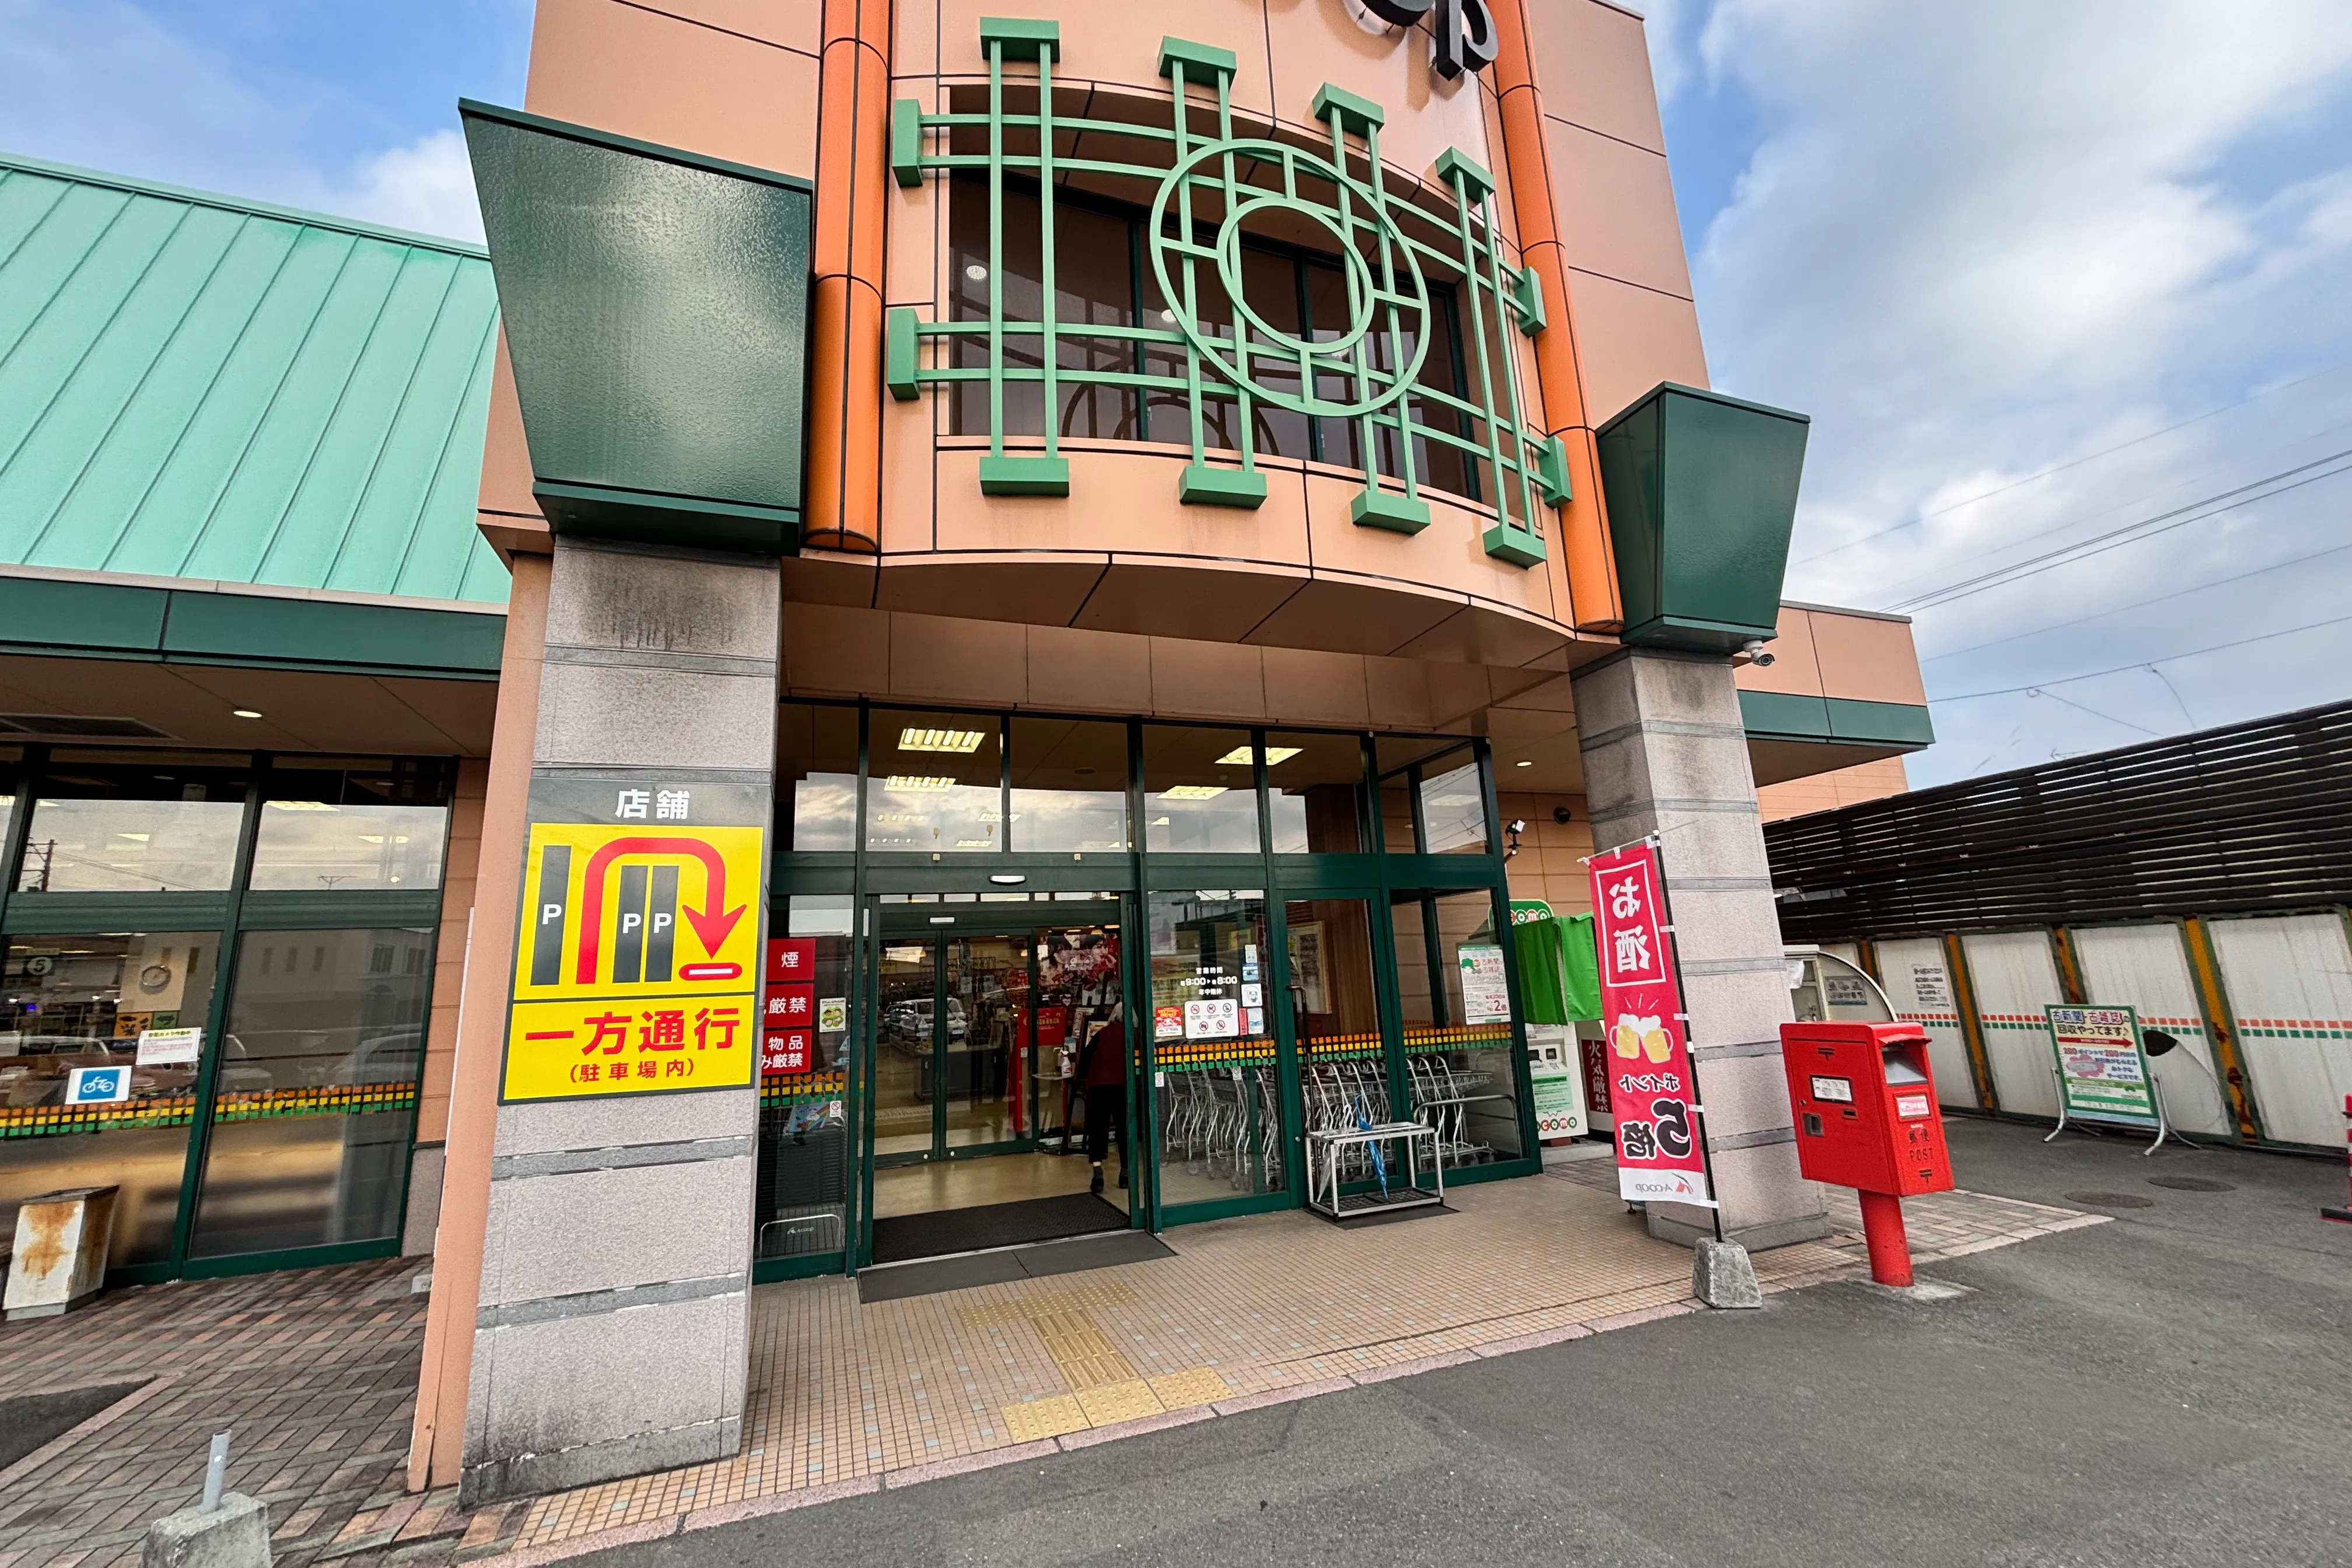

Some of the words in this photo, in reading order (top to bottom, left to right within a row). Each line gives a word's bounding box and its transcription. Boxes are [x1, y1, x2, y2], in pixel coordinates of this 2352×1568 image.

[615, 789, 690, 820] 店舗
[542, 904, 562, 925] P
[623, 913, 641, 934] P
[653, 912, 672, 933] P
[764, 996, 807, 1014] 厳禁
[525, 1007, 740, 1056] 一方通行
[1909, 1147, 1933, 1161] POST
